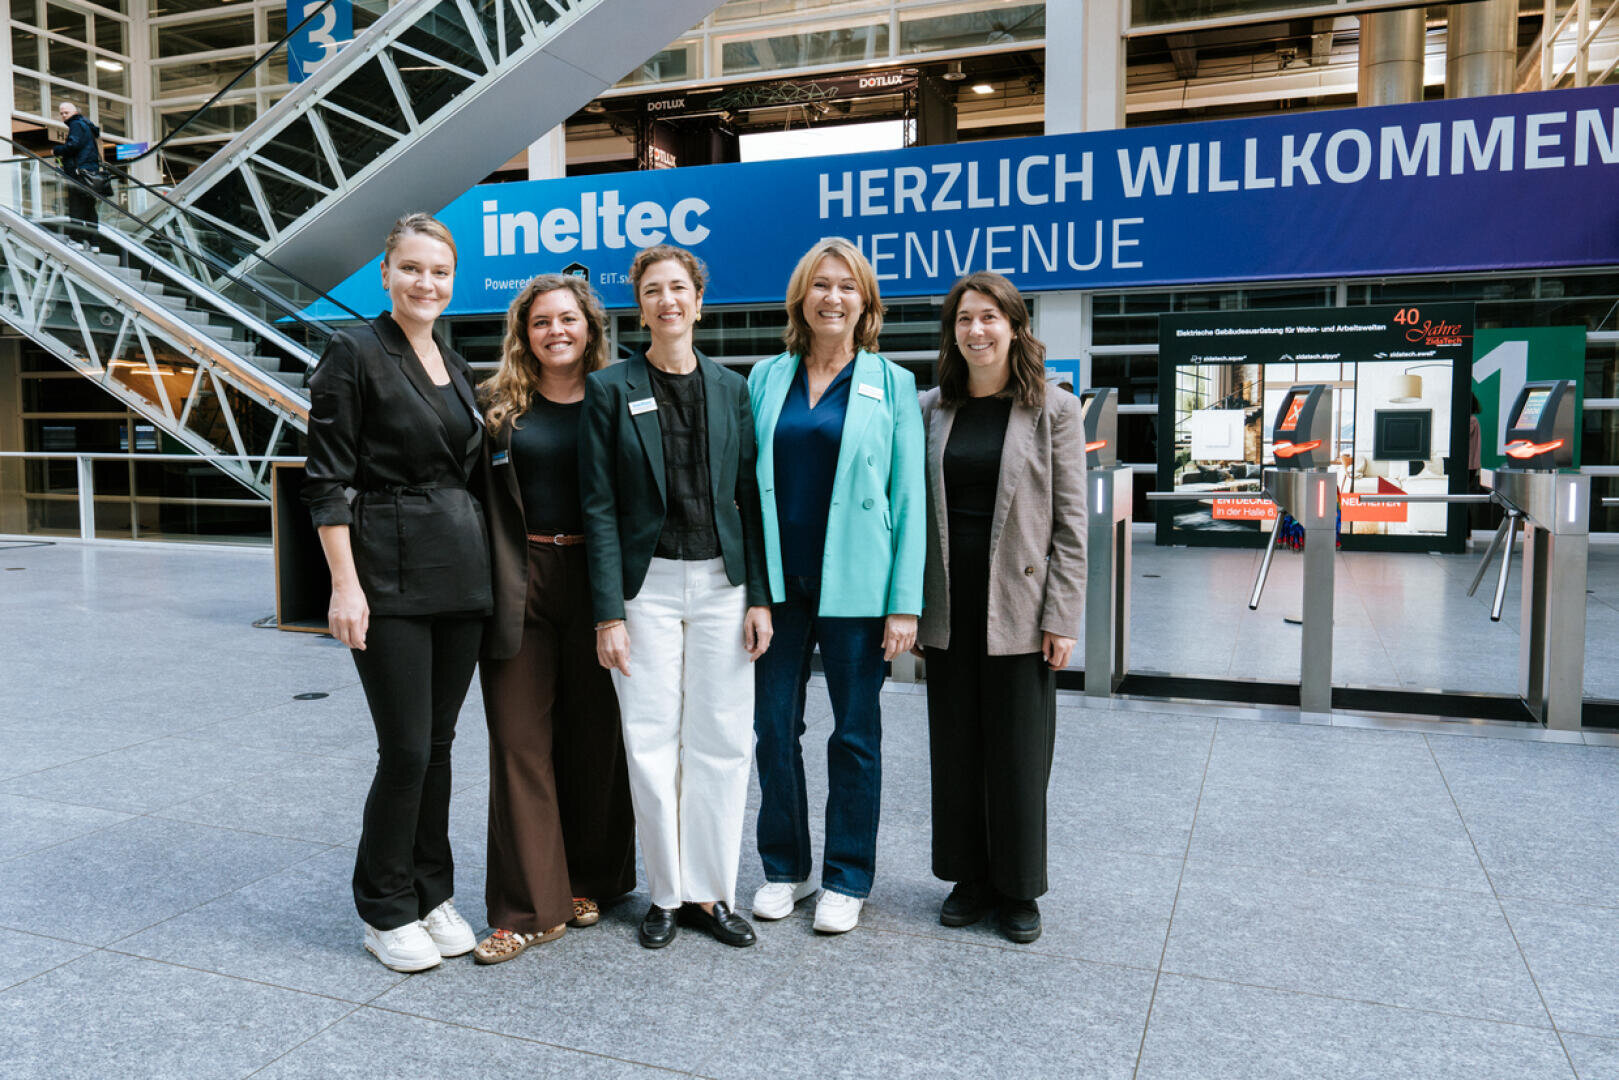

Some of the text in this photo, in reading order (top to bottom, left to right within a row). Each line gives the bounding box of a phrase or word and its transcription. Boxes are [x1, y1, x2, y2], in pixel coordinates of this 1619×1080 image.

[303, 1, 337, 74] 3
[859, 75, 903, 88] DOTLUX
[648, 99, 685, 111] DOTLUX
[819, 107, 1619, 219] HERZLICH WILLKOMMEN
[483, 190, 711, 257] ineltec
[820, 217, 1145, 281] ENVENUE
[1393, 308, 1420, 325] 40
[1176, 329, 1214, 337] Elektrische
[1285, 325, 1295, 334] für
[1296, 325, 1320, 334] Wohn-
[1321, 325, 1336, 333] und
[1405, 319, 1463, 342] Jahre
[1472, 341, 1529, 456] 1
[1216, 507, 1225, 516] in
[1226, 507, 1241, 516] der
[1243, 507, 1266, 517] Halle
